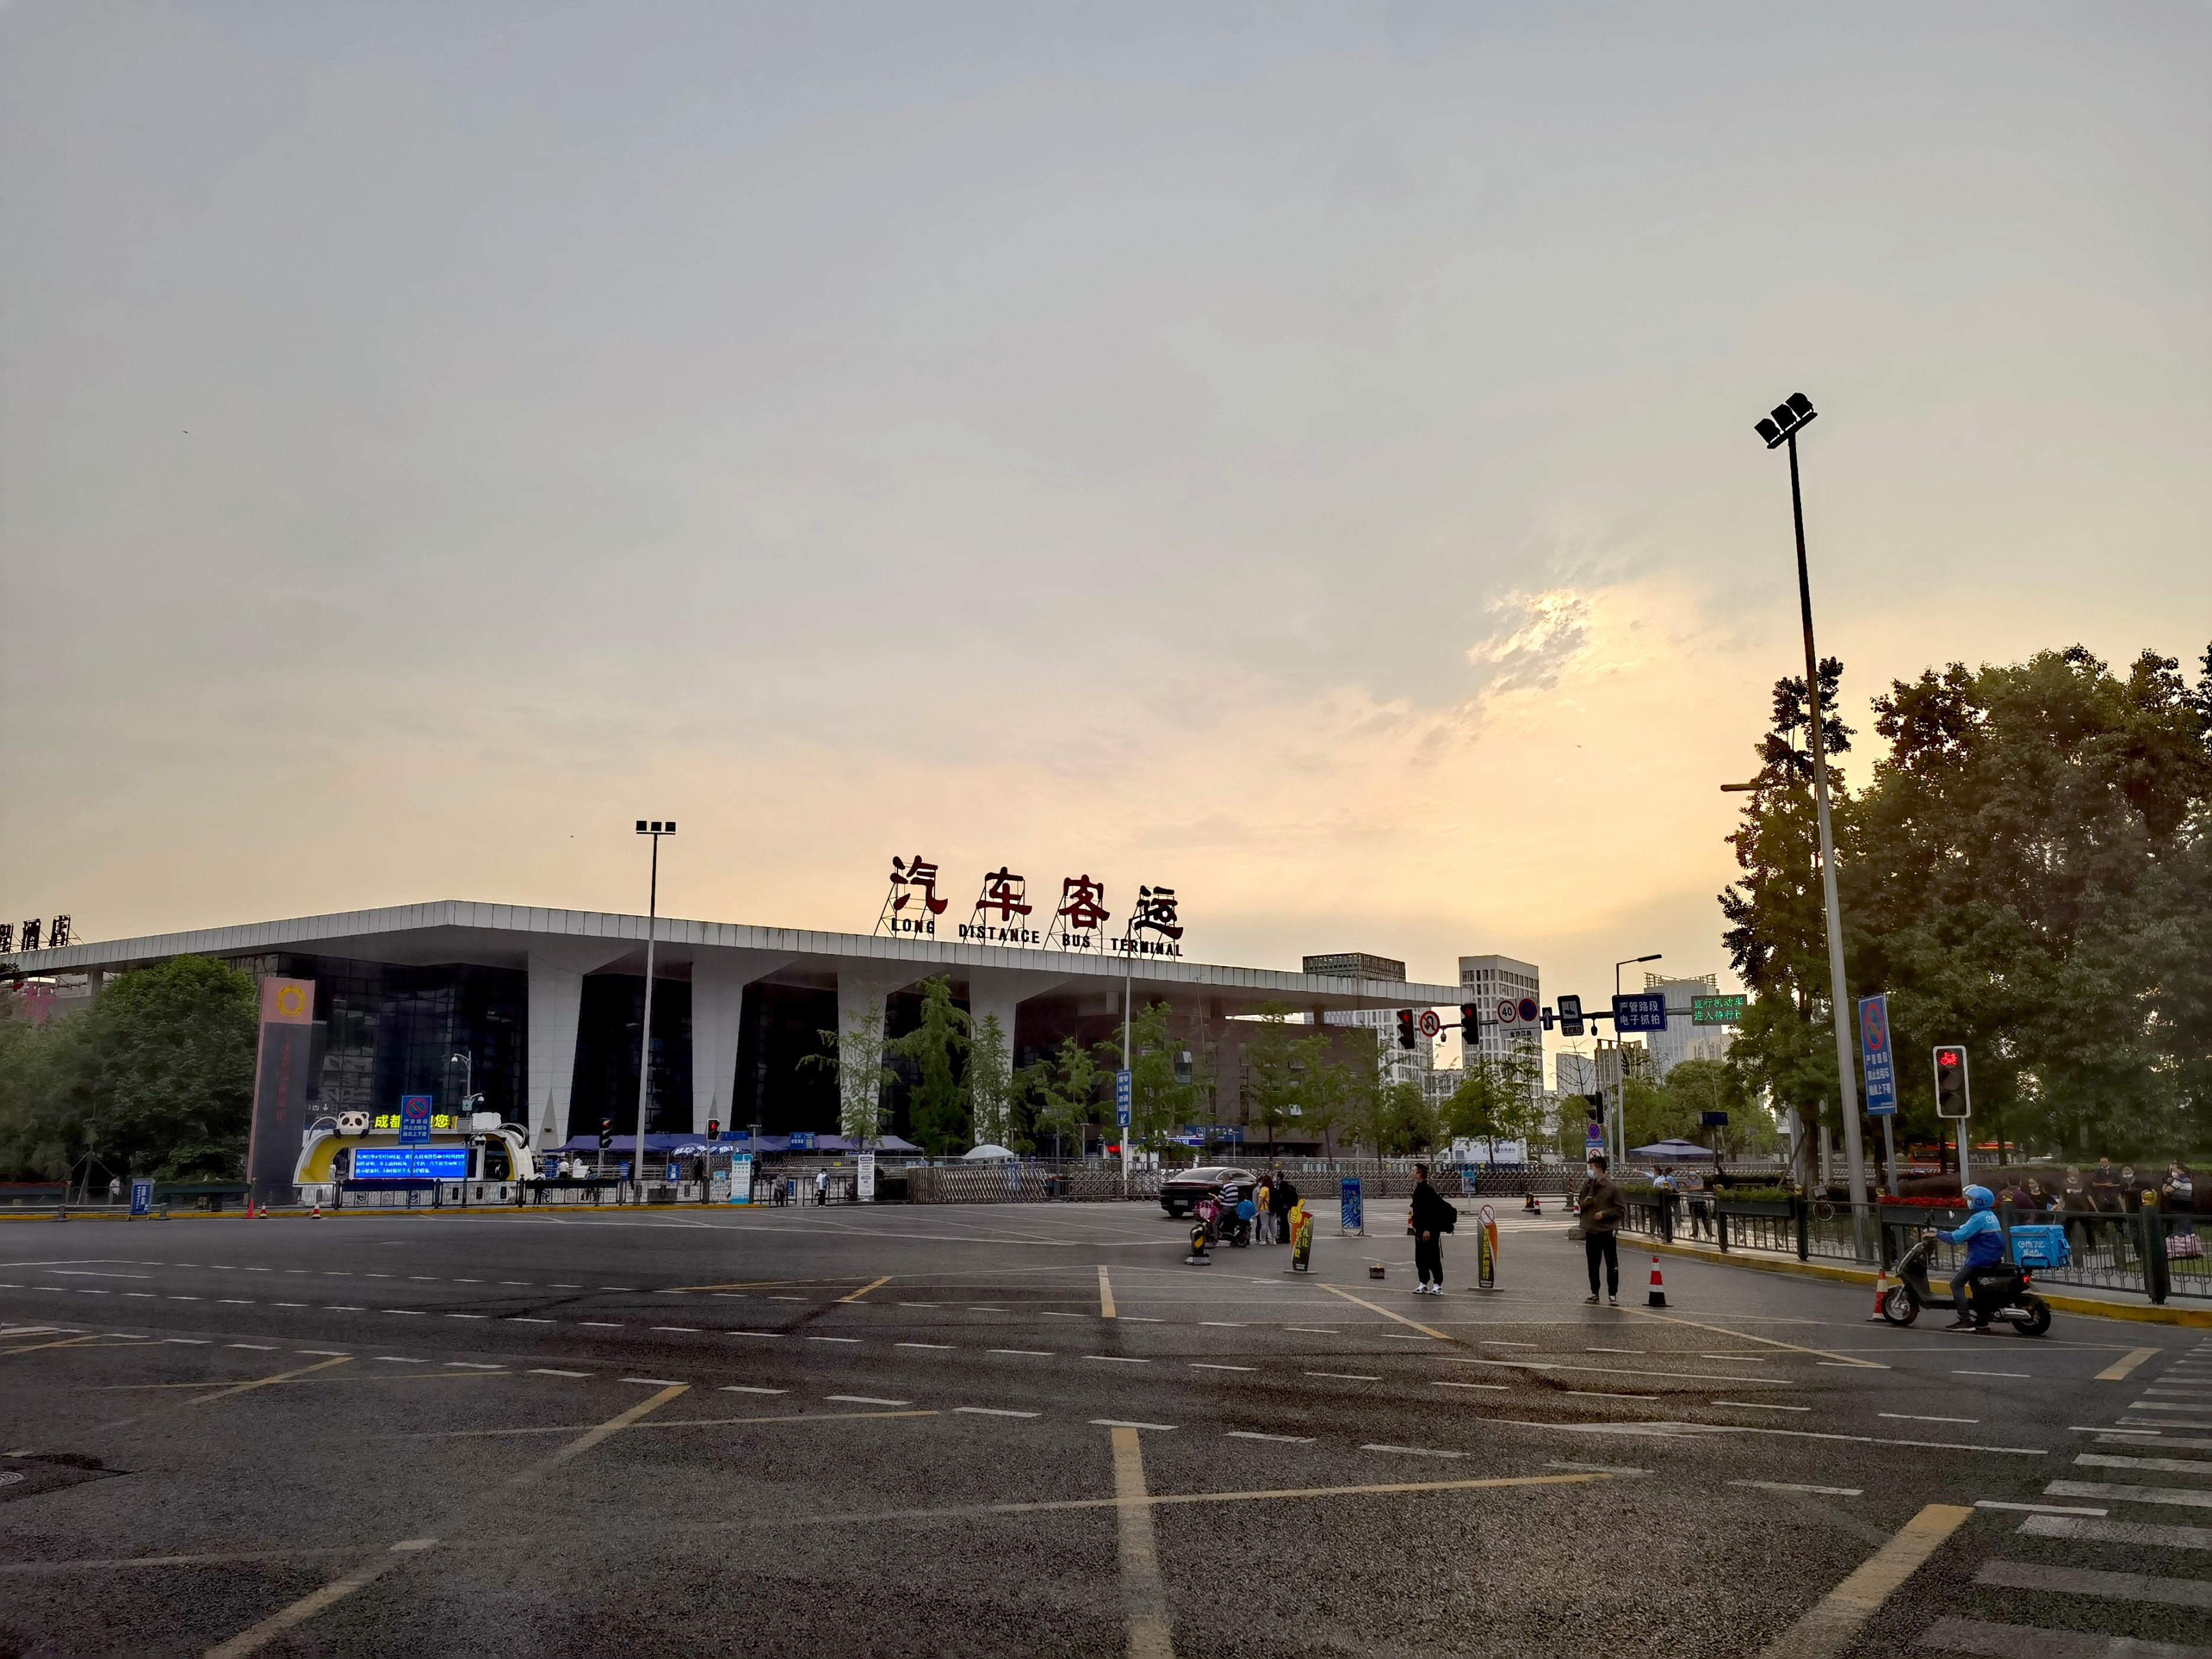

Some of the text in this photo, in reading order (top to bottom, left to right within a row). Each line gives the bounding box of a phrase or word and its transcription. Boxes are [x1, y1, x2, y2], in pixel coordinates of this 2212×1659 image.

[890, 855, 1184, 939] 汽车客运
[891, 918, 1183, 957] LONG DISTANCE BUS TERMINAL
[1619, 1000, 1659, 1014] 严管路段
[1694, 997, 1744, 1009] 直行机动车
[1502, 1007, 1512, 1016] 40
[1620, 1014, 1660, 1025] 电子抓拍
